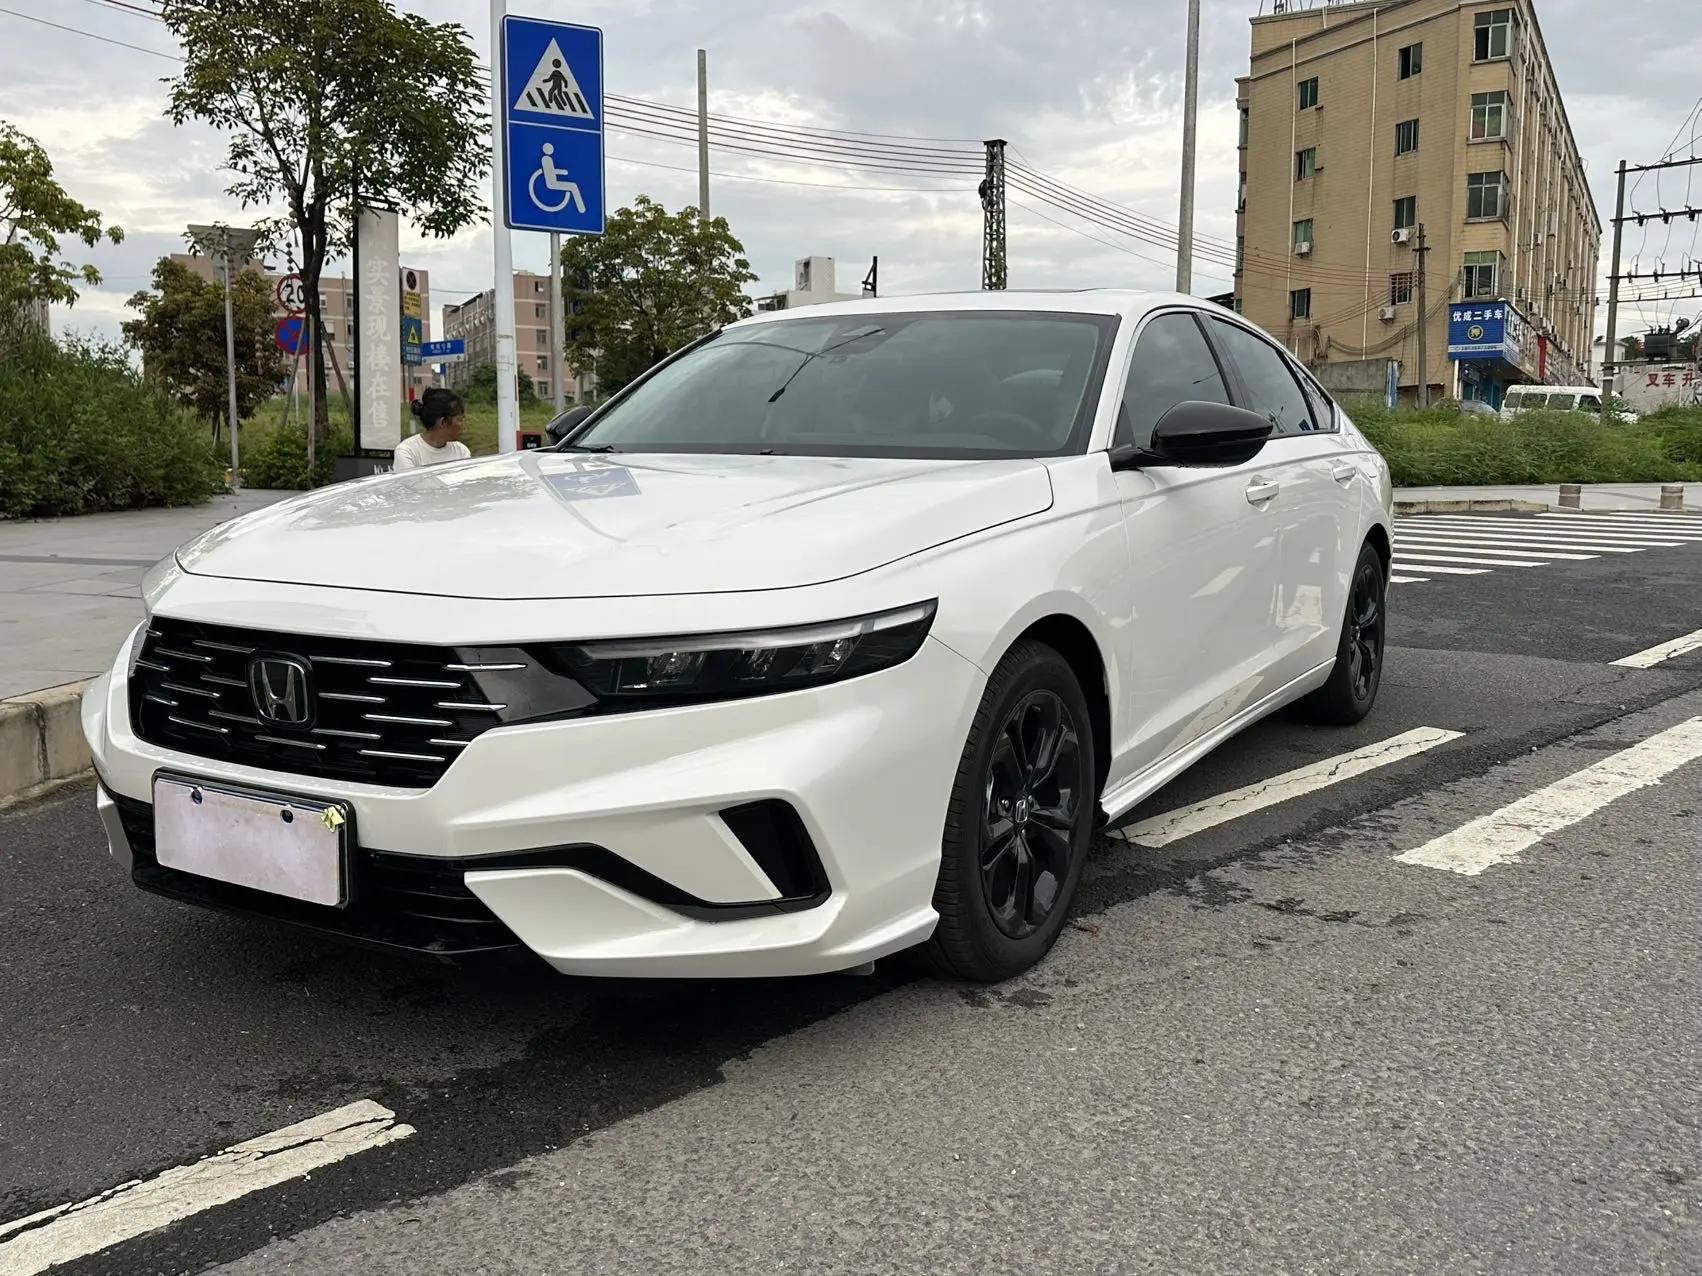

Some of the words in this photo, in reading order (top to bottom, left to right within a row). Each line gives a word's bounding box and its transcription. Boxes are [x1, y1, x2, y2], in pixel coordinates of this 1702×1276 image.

[1453, 309, 1503, 322] 优成二手车
[1646, 373, 1675, 388] 叉车
